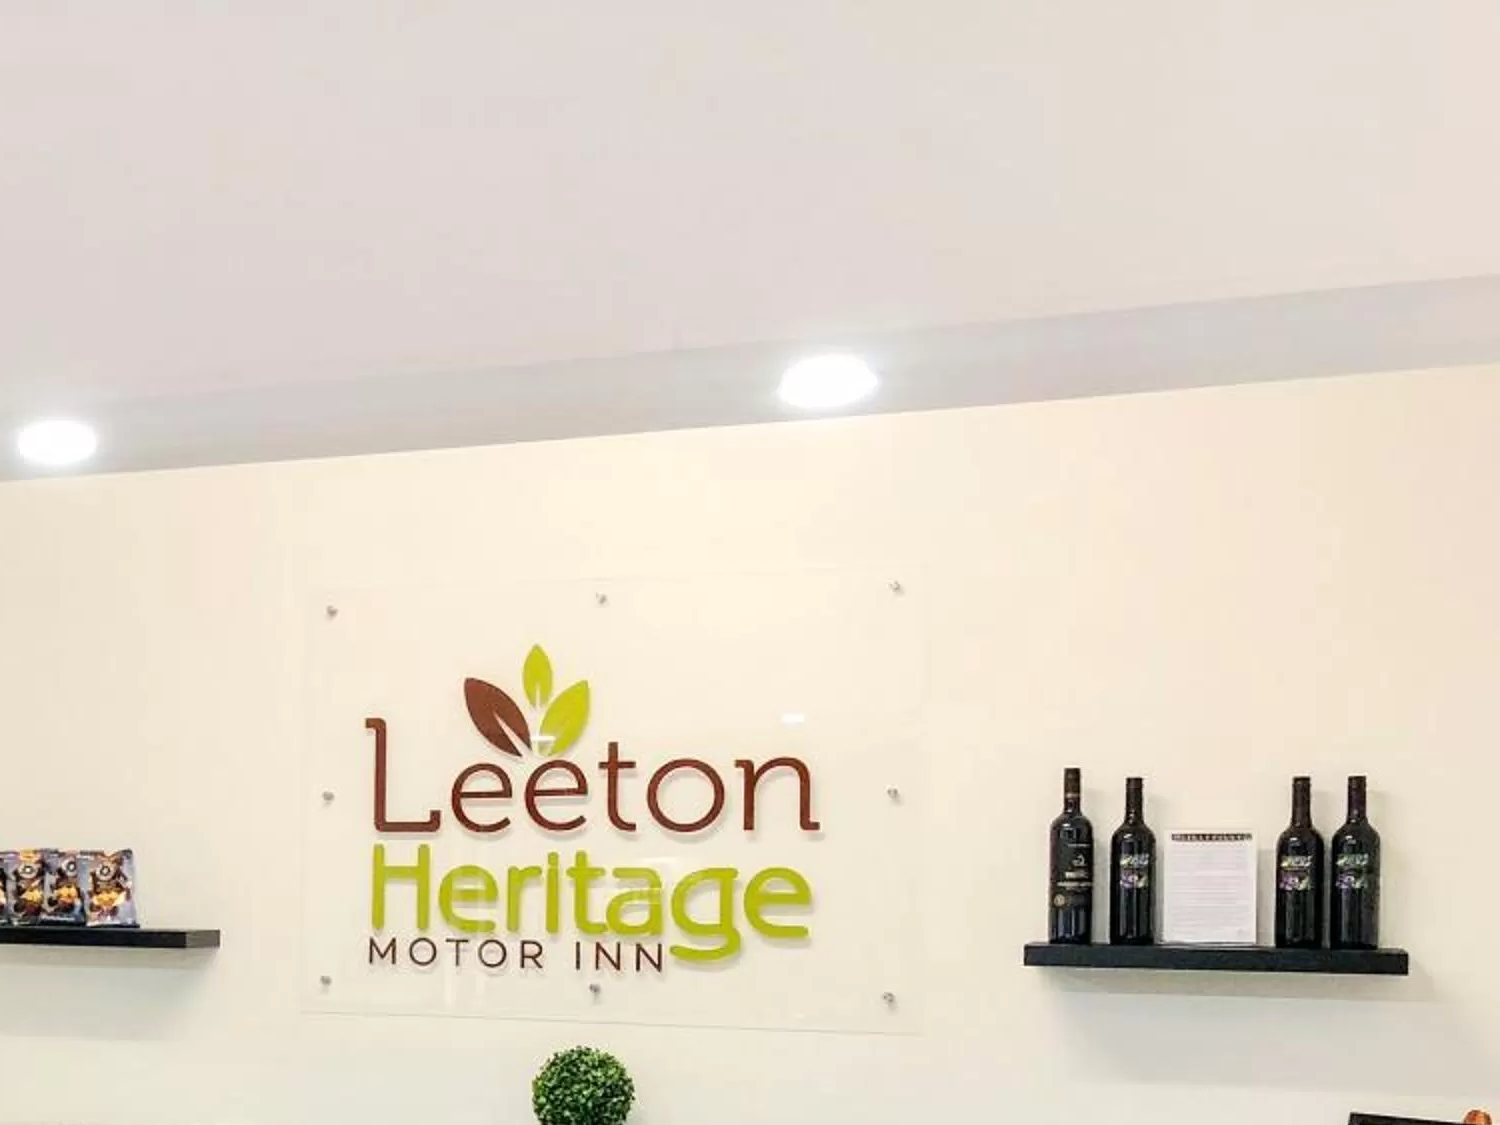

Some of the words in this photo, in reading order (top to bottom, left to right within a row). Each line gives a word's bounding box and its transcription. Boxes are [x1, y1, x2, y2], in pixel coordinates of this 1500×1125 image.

[365, 717, 820, 832] Leeton
[368, 937, 543, 969] MOTOR
[575, 941, 663, 972] INN
[371, 843, 812, 961] Heritage
